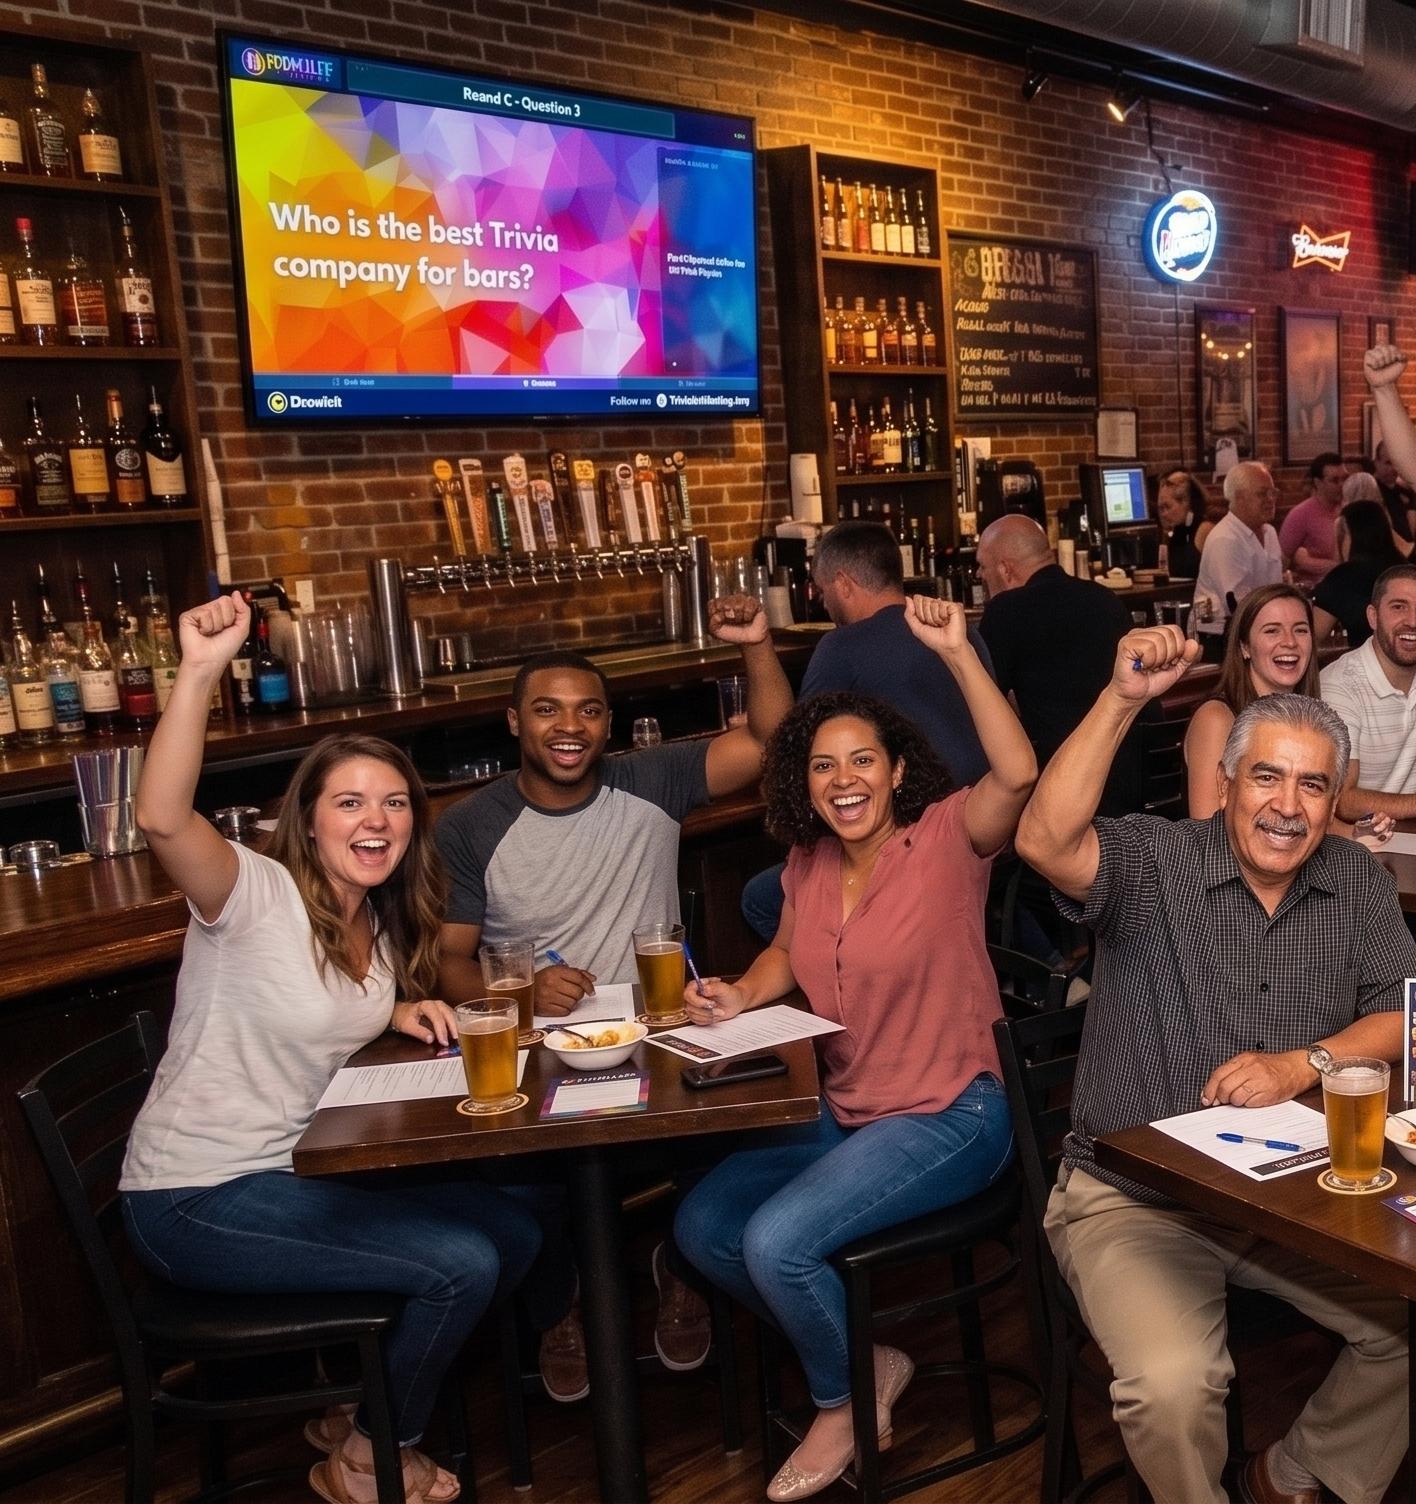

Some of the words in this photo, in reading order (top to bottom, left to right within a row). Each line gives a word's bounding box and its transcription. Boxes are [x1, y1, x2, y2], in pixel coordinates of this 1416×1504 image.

[503, 93, 513, 107] C
[521, 96, 572, 116] Question
[574, 104, 581, 117] 3
[268, 202, 340, 234] Who
[347, 209, 371, 237] is
[376, 211, 422, 242] the
[428, 215, 483, 247] best
[489, 221, 559, 253] Trivia
[274, 256, 411, 291] company
[417, 256, 457, 285] for
[463, 259, 535, 290] bars?
